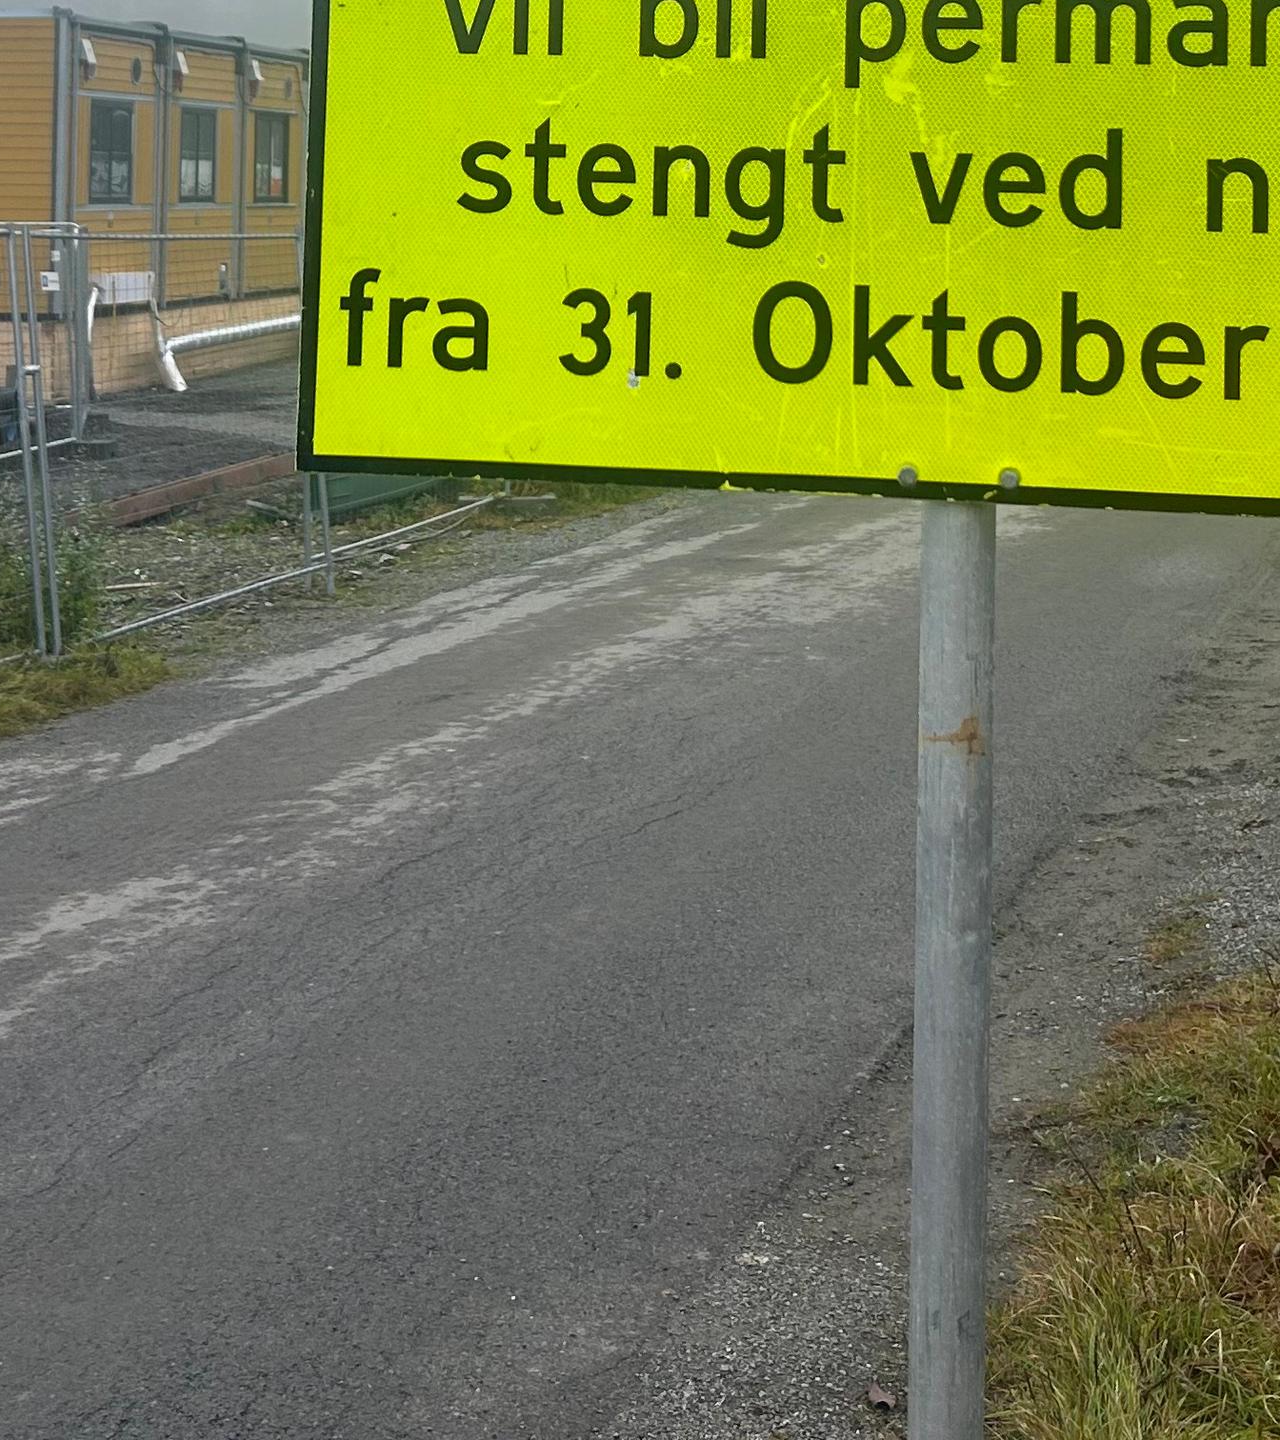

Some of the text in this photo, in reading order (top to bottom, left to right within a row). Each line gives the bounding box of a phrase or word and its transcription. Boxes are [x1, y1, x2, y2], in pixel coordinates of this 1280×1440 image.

[456, 117, 847, 250] stengt
[909, 128, 1124, 231] ved
[339, 267, 489, 372] fra
[558, 288, 682, 380] 31.
[752, 280, 1271, 401] Oktober
